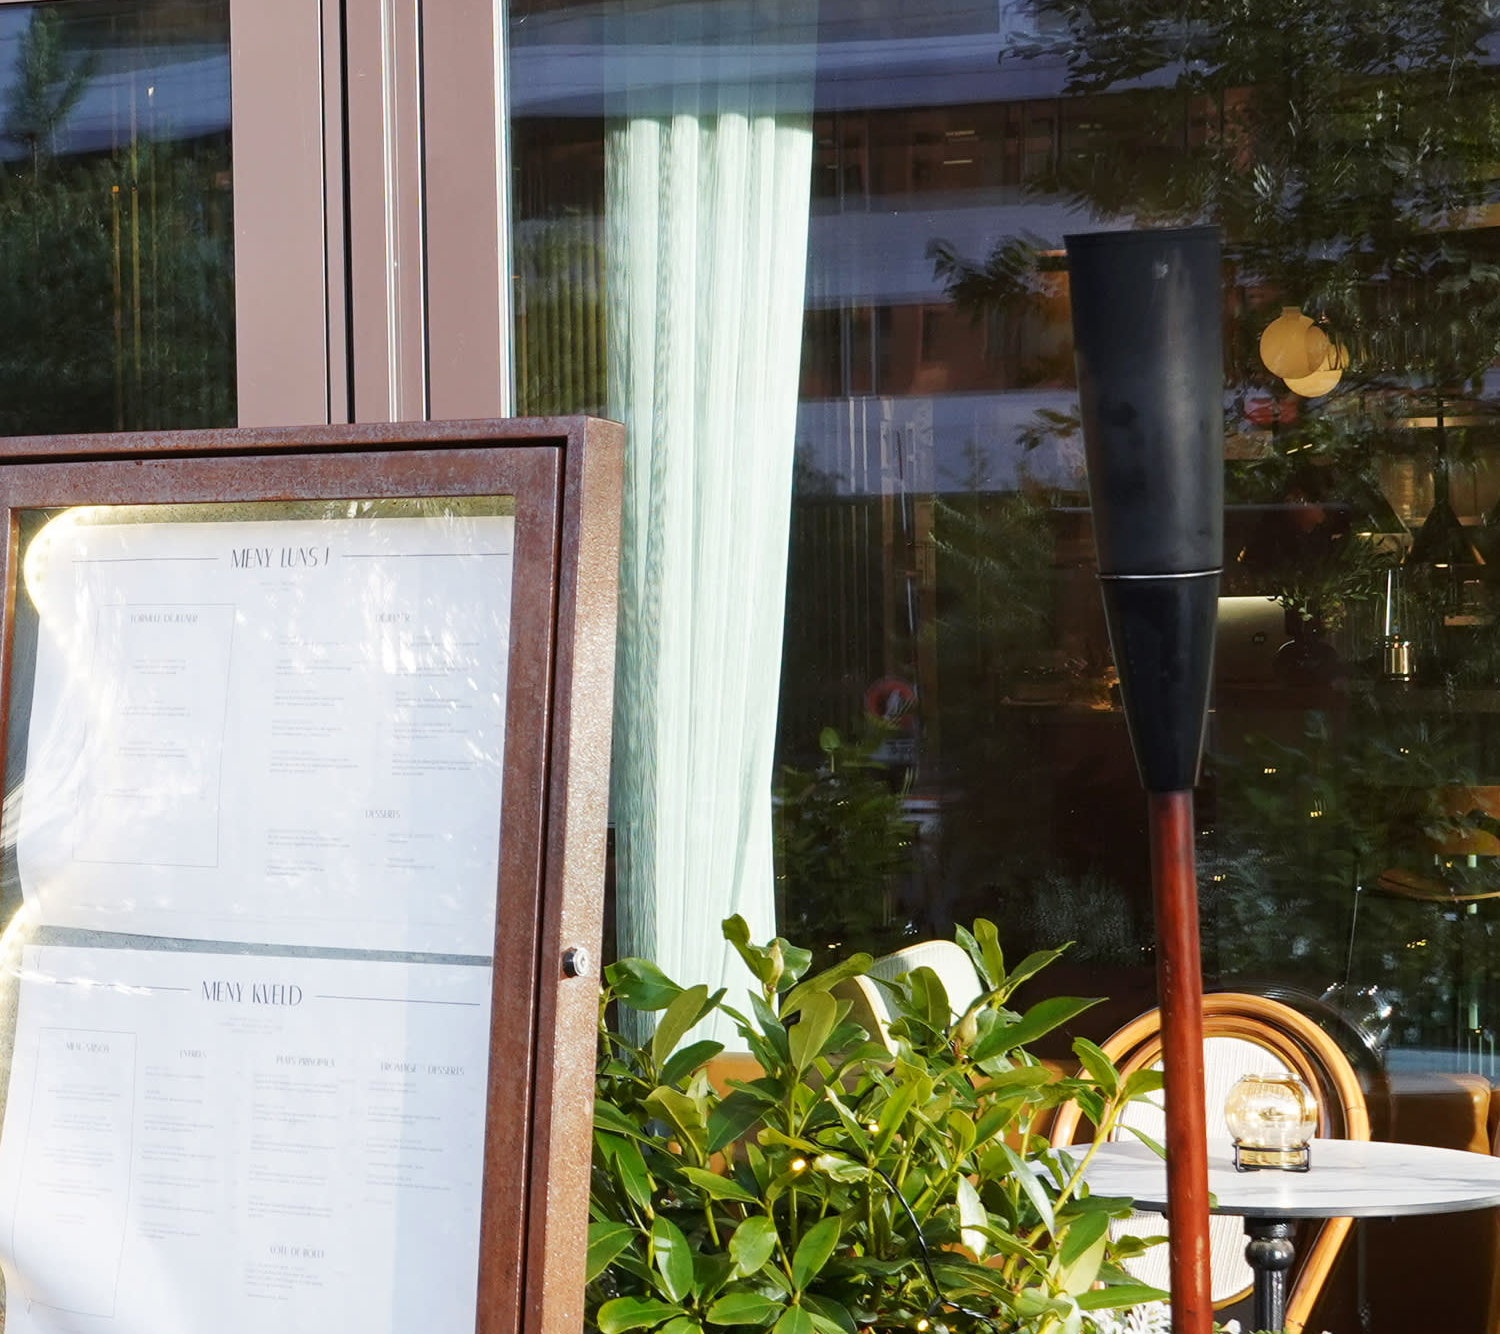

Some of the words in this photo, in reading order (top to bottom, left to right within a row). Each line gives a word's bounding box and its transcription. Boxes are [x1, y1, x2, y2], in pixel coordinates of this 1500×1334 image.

[231, 547, 273, 569] MENY
[202, 980, 243, 1003] MENY
[252, 983, 303, 1006] KVELD
